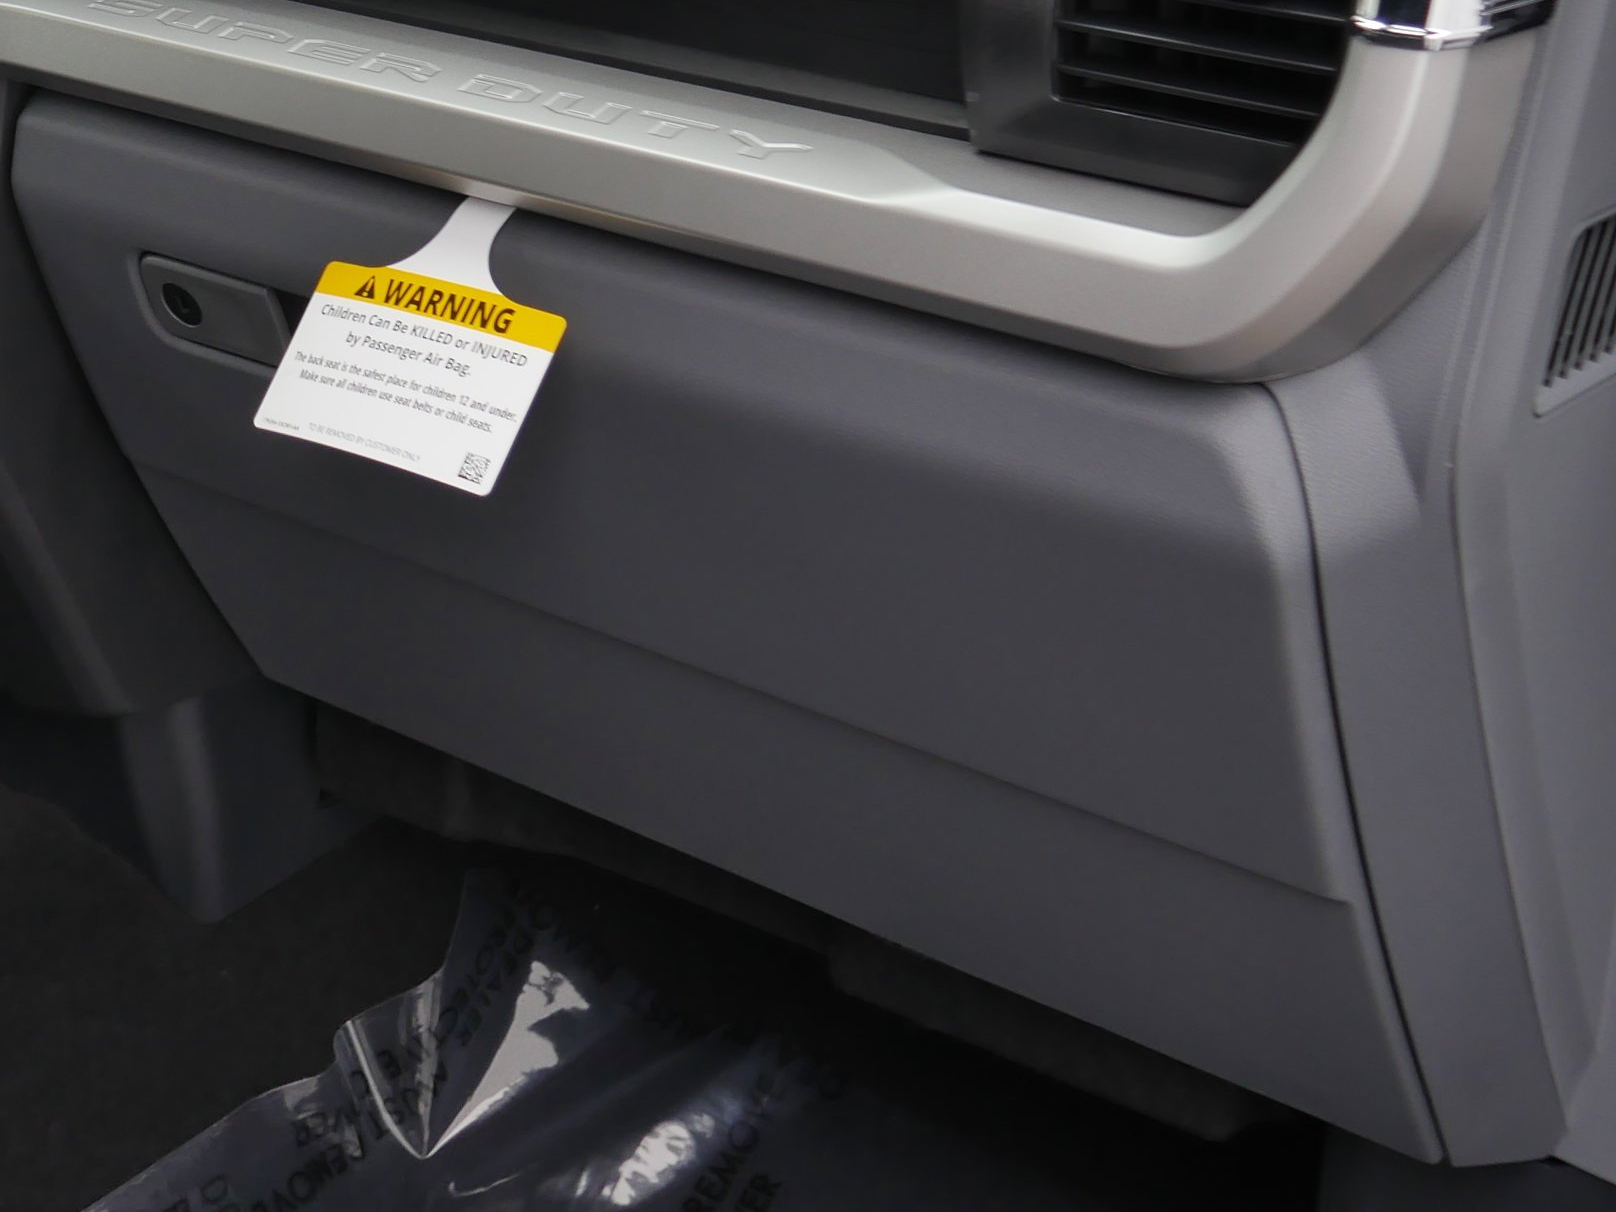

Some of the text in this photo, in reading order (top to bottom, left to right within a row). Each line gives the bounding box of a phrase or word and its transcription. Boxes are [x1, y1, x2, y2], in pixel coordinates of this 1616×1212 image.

[456, 73, 813, 160] DUTY
[321, 303, 528, 367] Children Can Be KILLED or INJURED
[384, 278, 516, 334] WARNING
[295, 351, 307, 363] The
[307, 353, 324, 366] back
[324, 358, 341, 370] seat
[348, 364, 362, 376] the
[362, 368, 386, 382] safest
[386, 374, 408, 388] place
[409, 379, 422, 391] for
[422, 384, 457, 403] children
[458, 395, 470, 407] 12
[470, 399, 487, 413] and
[345, 331, 472, 378] by Passenger Air Bag.
[299, 368, 319, 383] Make
[319, 375, 336, 387] sure
[336, 378, 347, 389] all
[347, 380, 378, 398] children
[378, 391, 393, 402] use
[393, 394, 412, 407] seat
[412, 399, 433, 414] belts
[445, 409, 467, 424] child
